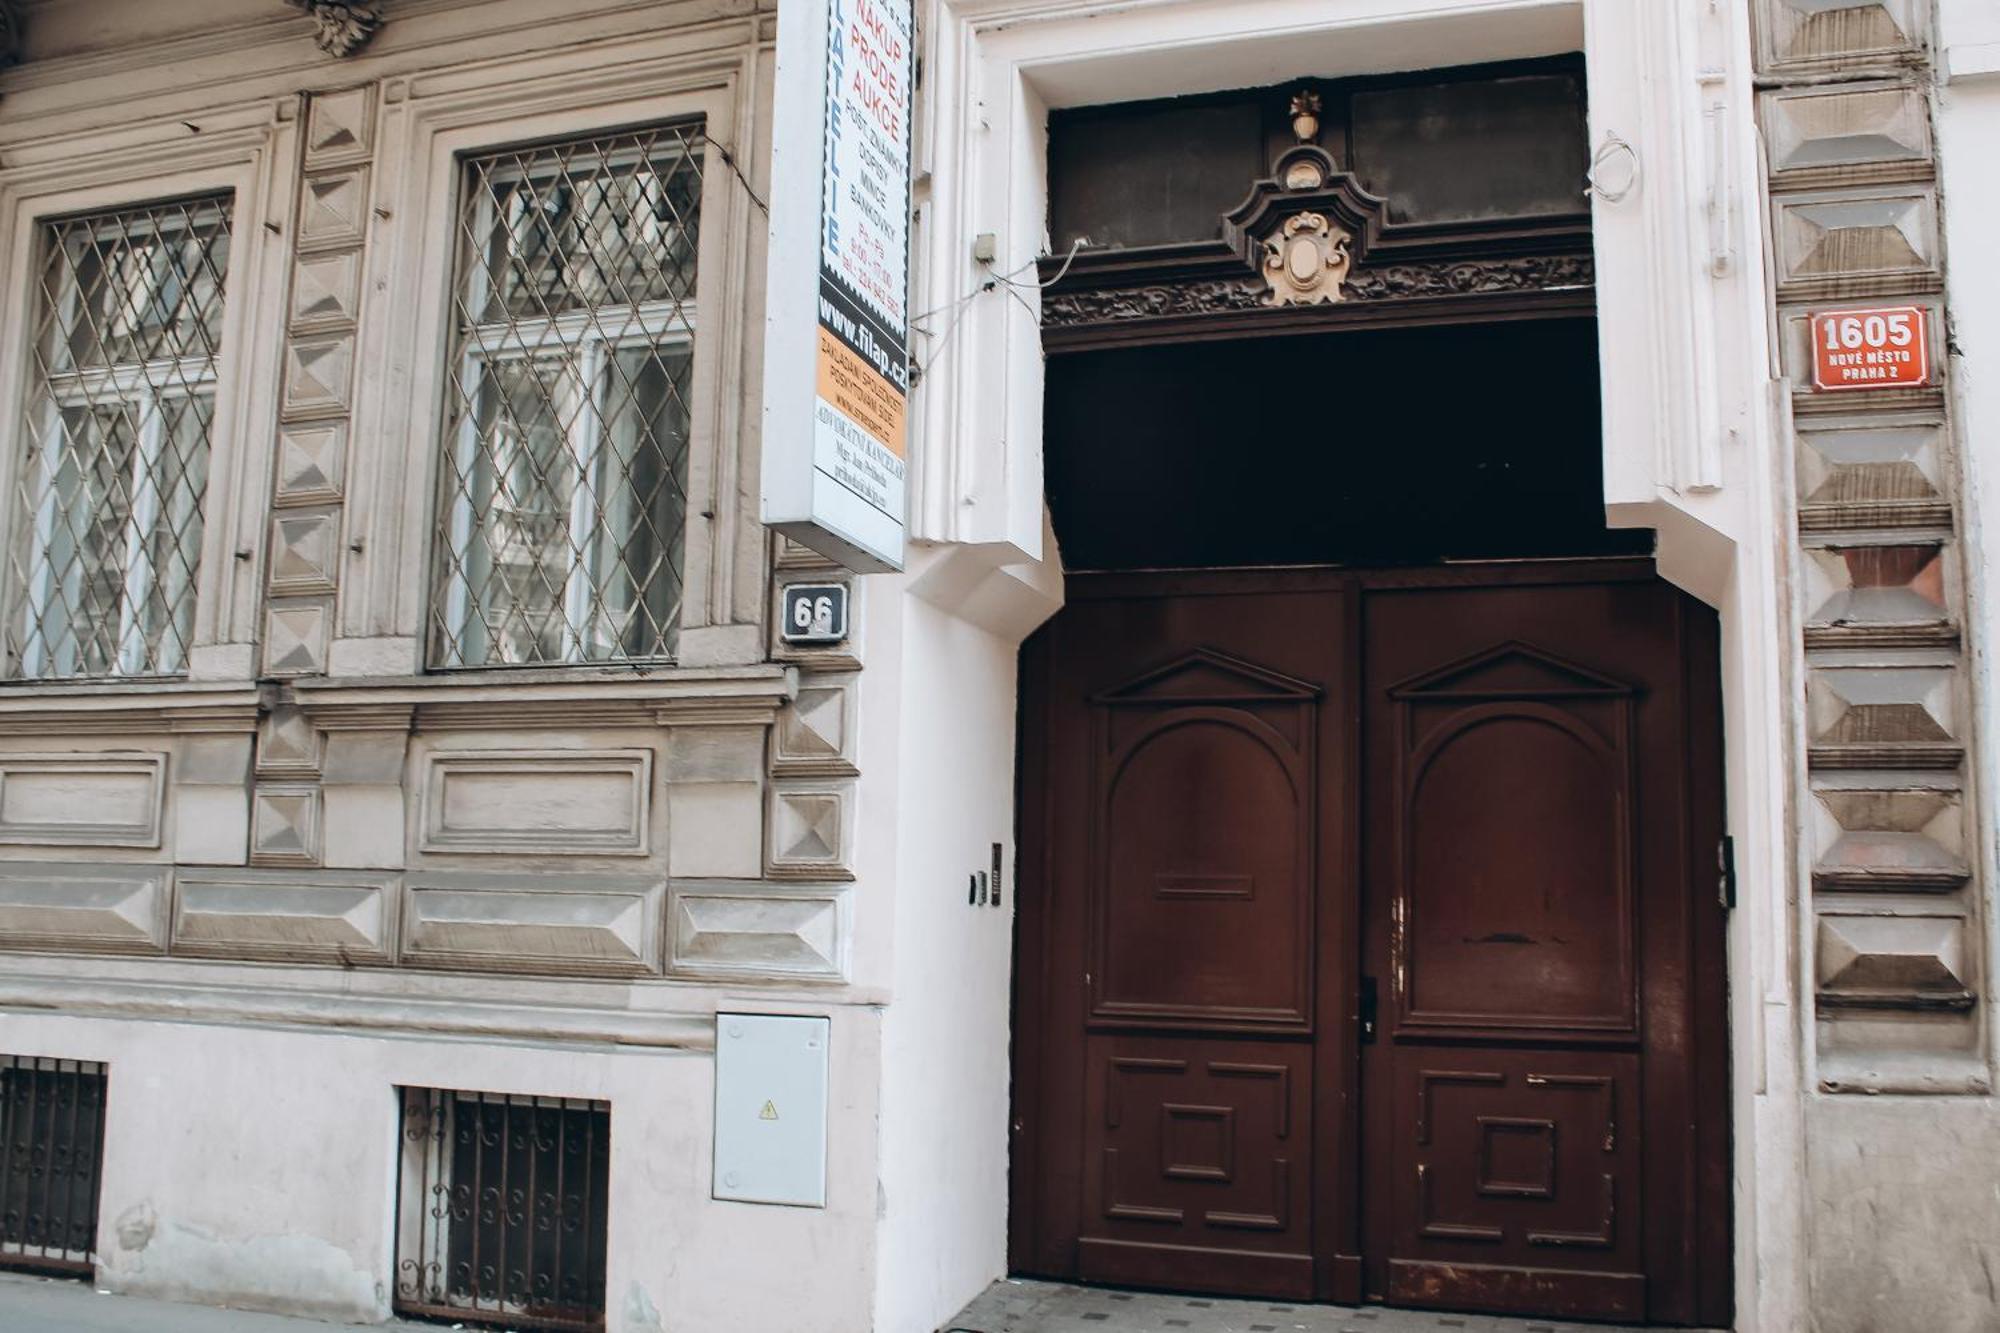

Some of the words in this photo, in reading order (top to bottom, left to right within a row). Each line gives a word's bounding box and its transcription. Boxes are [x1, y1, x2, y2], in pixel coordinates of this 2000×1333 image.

[852, 22, 903, 109] PRODEJ
[853, 68, 898, 143] AUKCE
[859, 140, 888, 187] DOPISY
[860, 168, 886, 210] MINCE
[850, 183, 895, 244] BANKOVKY
[820, 296, 905, 391] www.filap.cz
[1825, 314, 1912, 350] 1605
[1828, 351, 1863, 366] NOVÉ
[1866, 350, 1911, 364] MĚSTO
[1842, 366, 1887, 380] PRAHA
[1889, 366, 1898, 378] 2
[794, 595, 833, 629] 66
